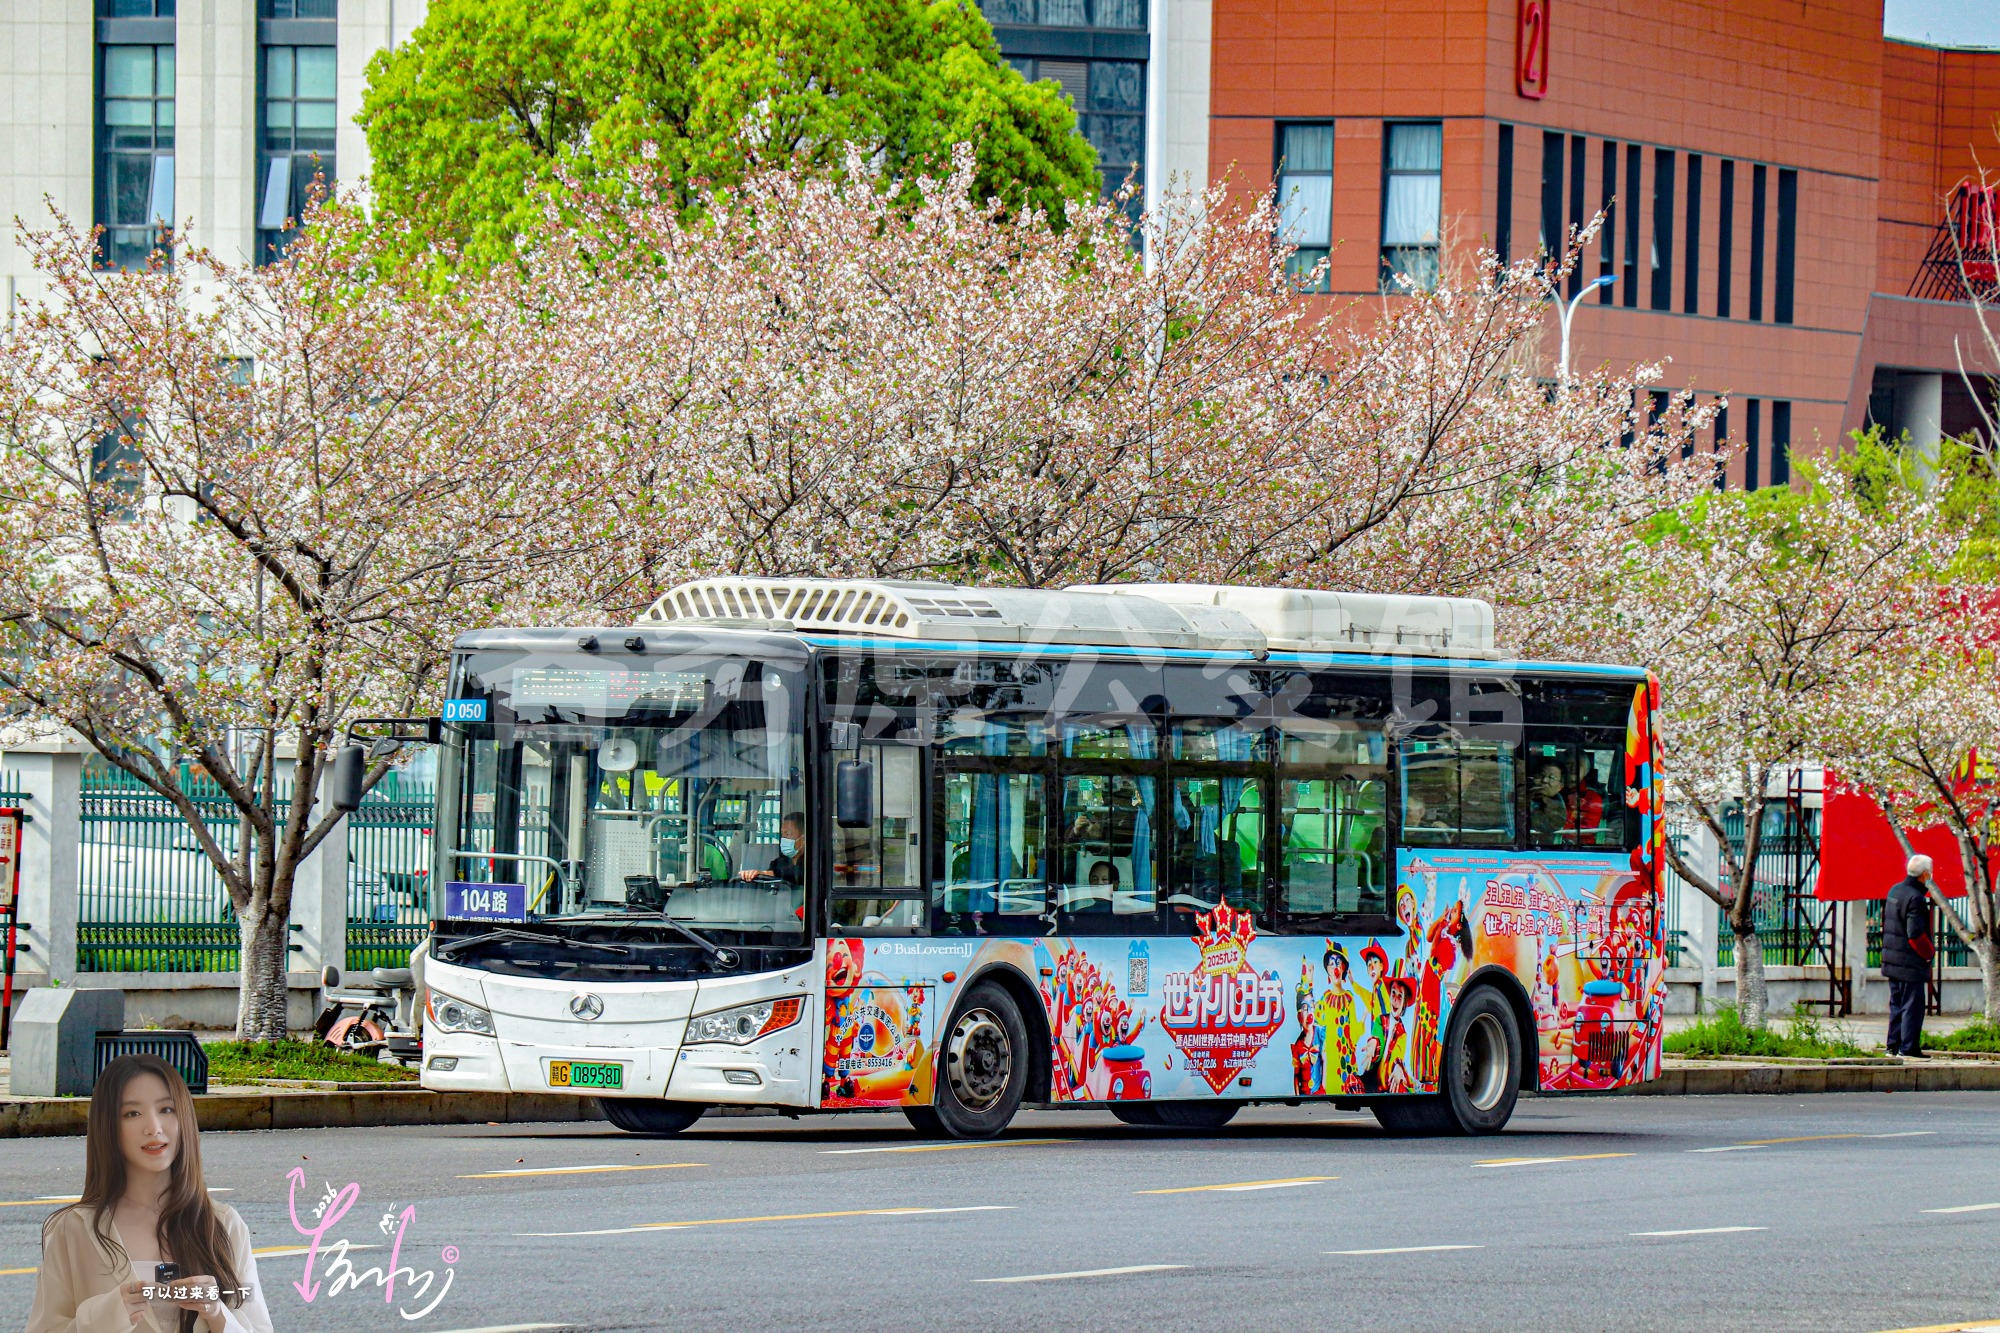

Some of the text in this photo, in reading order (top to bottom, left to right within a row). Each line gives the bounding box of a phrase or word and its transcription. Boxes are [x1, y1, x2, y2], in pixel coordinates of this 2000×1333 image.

[1525, 2, 1541, 83] 2
[447, 703, 482, 718] D 050
[460, 889, 507, 913] 104路
[1485, 880, 1526, 909] 丑丑丑
[1483, 911, 1563, 938] 世界小丑大集结
[1207, 951, 1238, 967] 2025九江
[1163, 973, 1284, 1027] 世界小丑节
[867, 1058, 893, 1067] 8553416
